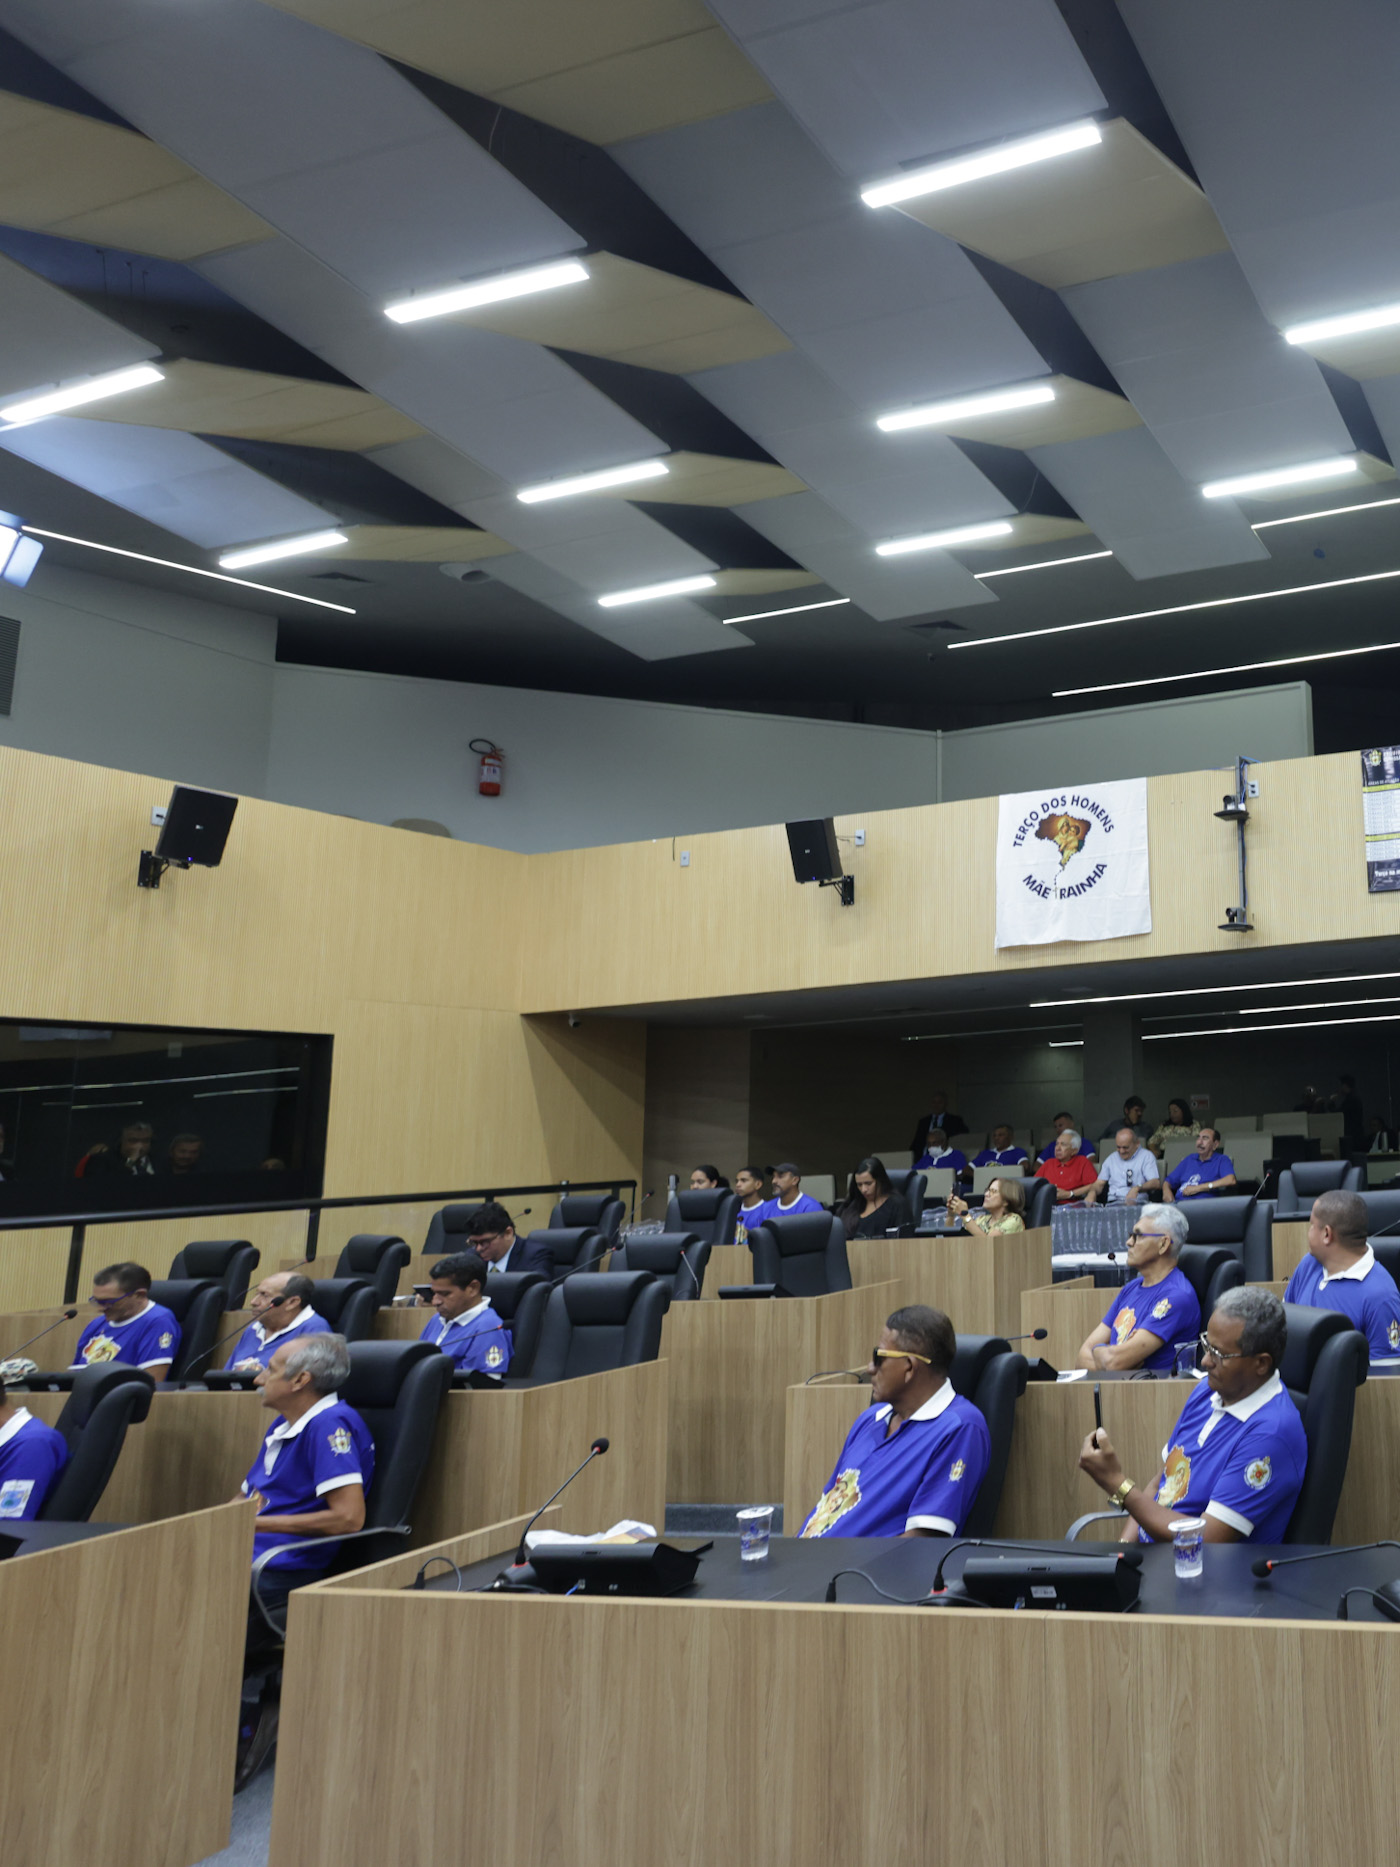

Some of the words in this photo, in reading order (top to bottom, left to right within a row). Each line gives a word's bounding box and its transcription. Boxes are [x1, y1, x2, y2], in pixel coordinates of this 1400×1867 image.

[1013, 810, 1039, 848] TERÇO
[1041, 795, 1067, 813] DOS
[1071, 795, 1114, 833] HOMENS
[1022, 874, 1051, 899] MÃE
[1059, 862, 1108, 900] RAINHA
